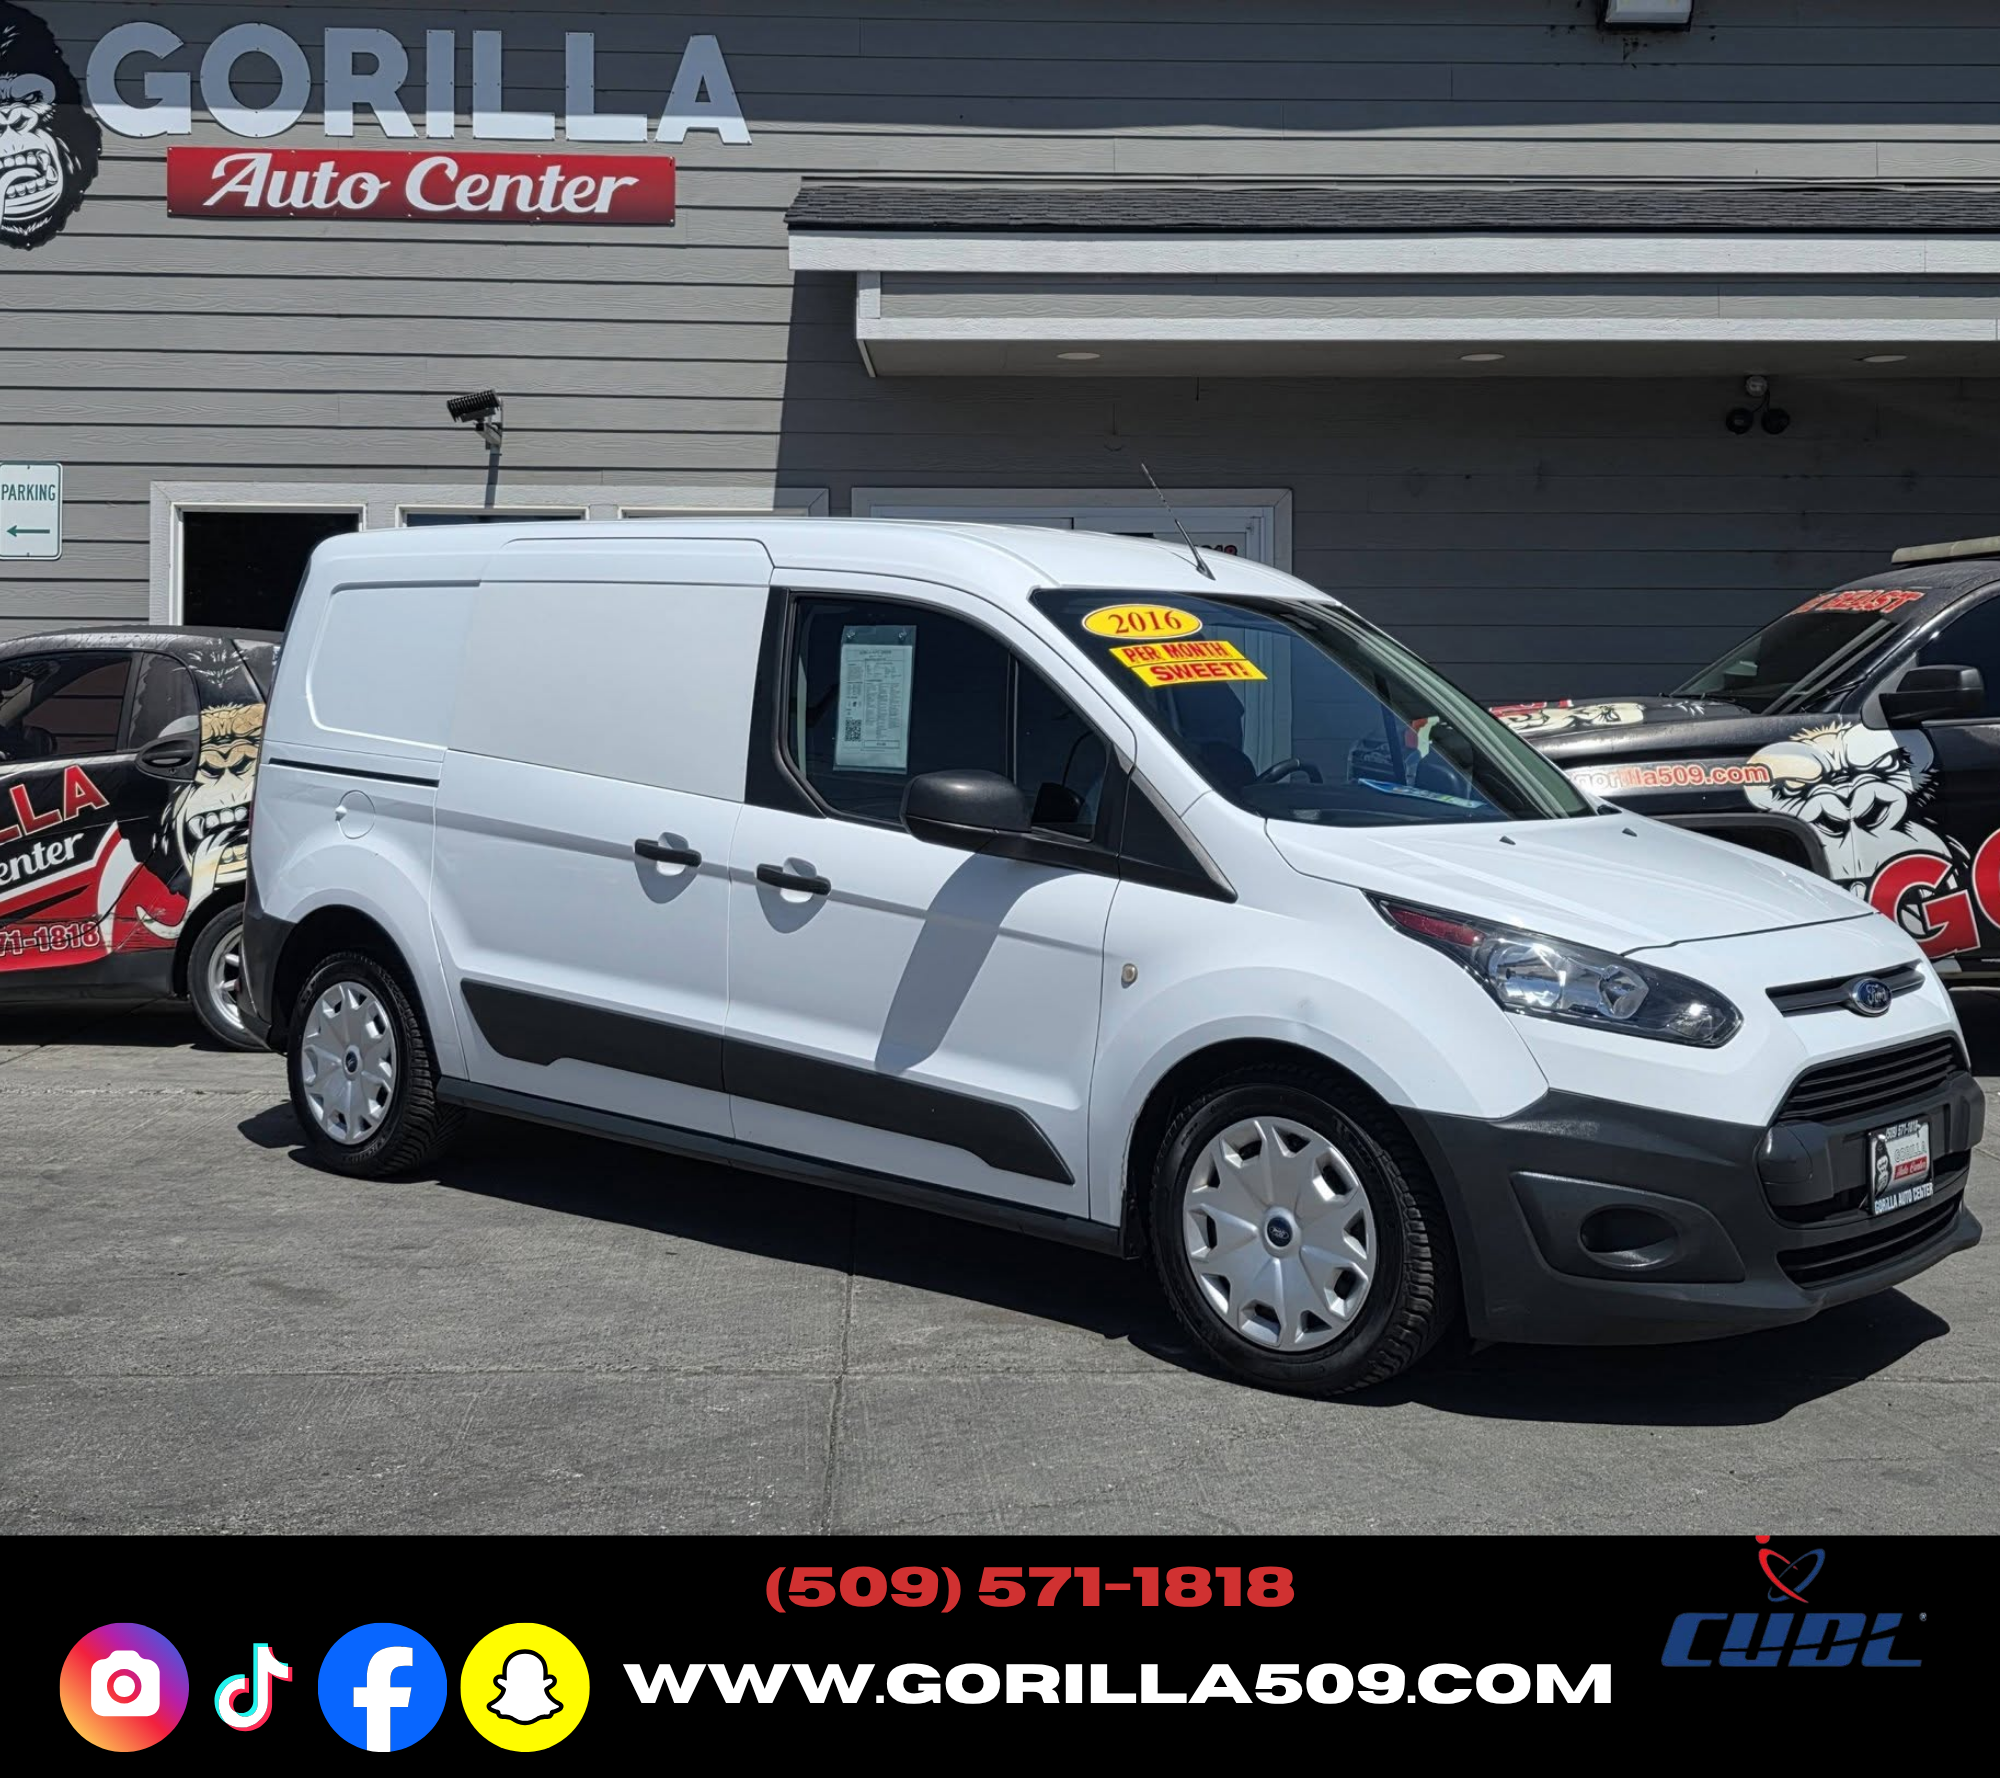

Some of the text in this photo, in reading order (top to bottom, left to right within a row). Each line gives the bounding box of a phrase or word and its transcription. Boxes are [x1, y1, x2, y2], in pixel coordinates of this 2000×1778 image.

[86, 22, 752, 145] GORILLA
[203, 152, 639, 214] Auto Center
[1, 484, 56, 501] PARKING
[1108, 610, 1182, 634] 2016
[1122, 641, 1230, 663] PER MONTH
[1150, 662, 1249, 682] SWEET!
[1875, 1182, 1934, 1216] GORILLA AUTO CENTER
